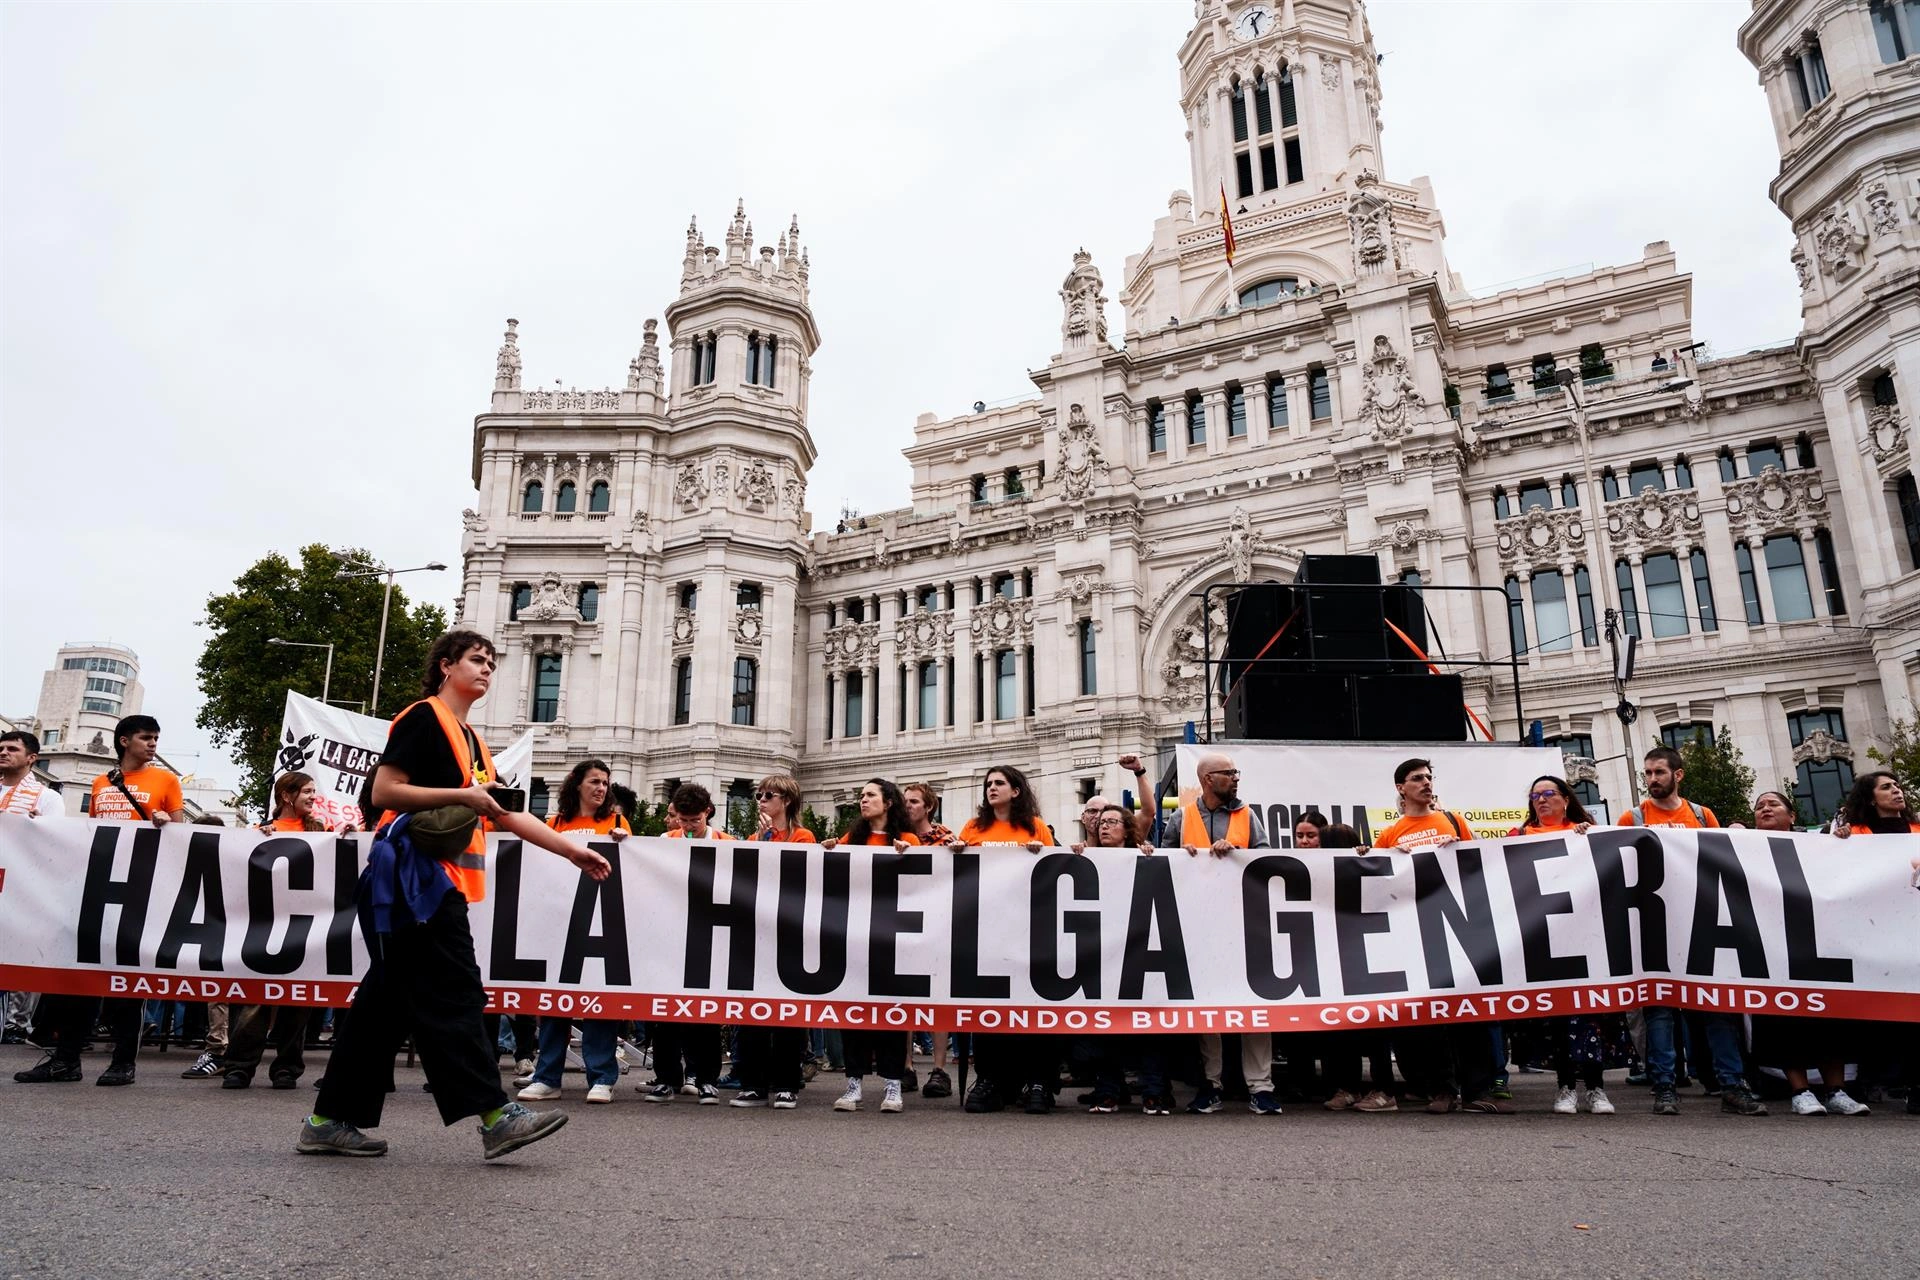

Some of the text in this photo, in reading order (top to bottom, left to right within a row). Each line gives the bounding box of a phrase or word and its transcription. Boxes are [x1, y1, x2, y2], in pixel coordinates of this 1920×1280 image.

[322, 741, 380, 772] LA CAS
[335, 772, 359, 796] EN
[1464, 810, 1522, 822] QUILERES
[1398, 828, 1438, 844] SINDICATO
[77, 826, 1854, 1002] HACI LA HUELGA GENERAL
[110, 975, 246, 1000] BAJADA
[264, 982, 329, 1002] DEL
[537, 992, 603, 1014] 50%
[651, 998, 935, 1026] EXPROPIACIÓN
[956, 1009, 1112, 1029] FONDOS
[1132, 1009, 1270, 1030] BUITRE
[1319, 992, 1554, 1027] CONTRATOS
[1573, 981, 1827, 1012] INDEFINIDOS
